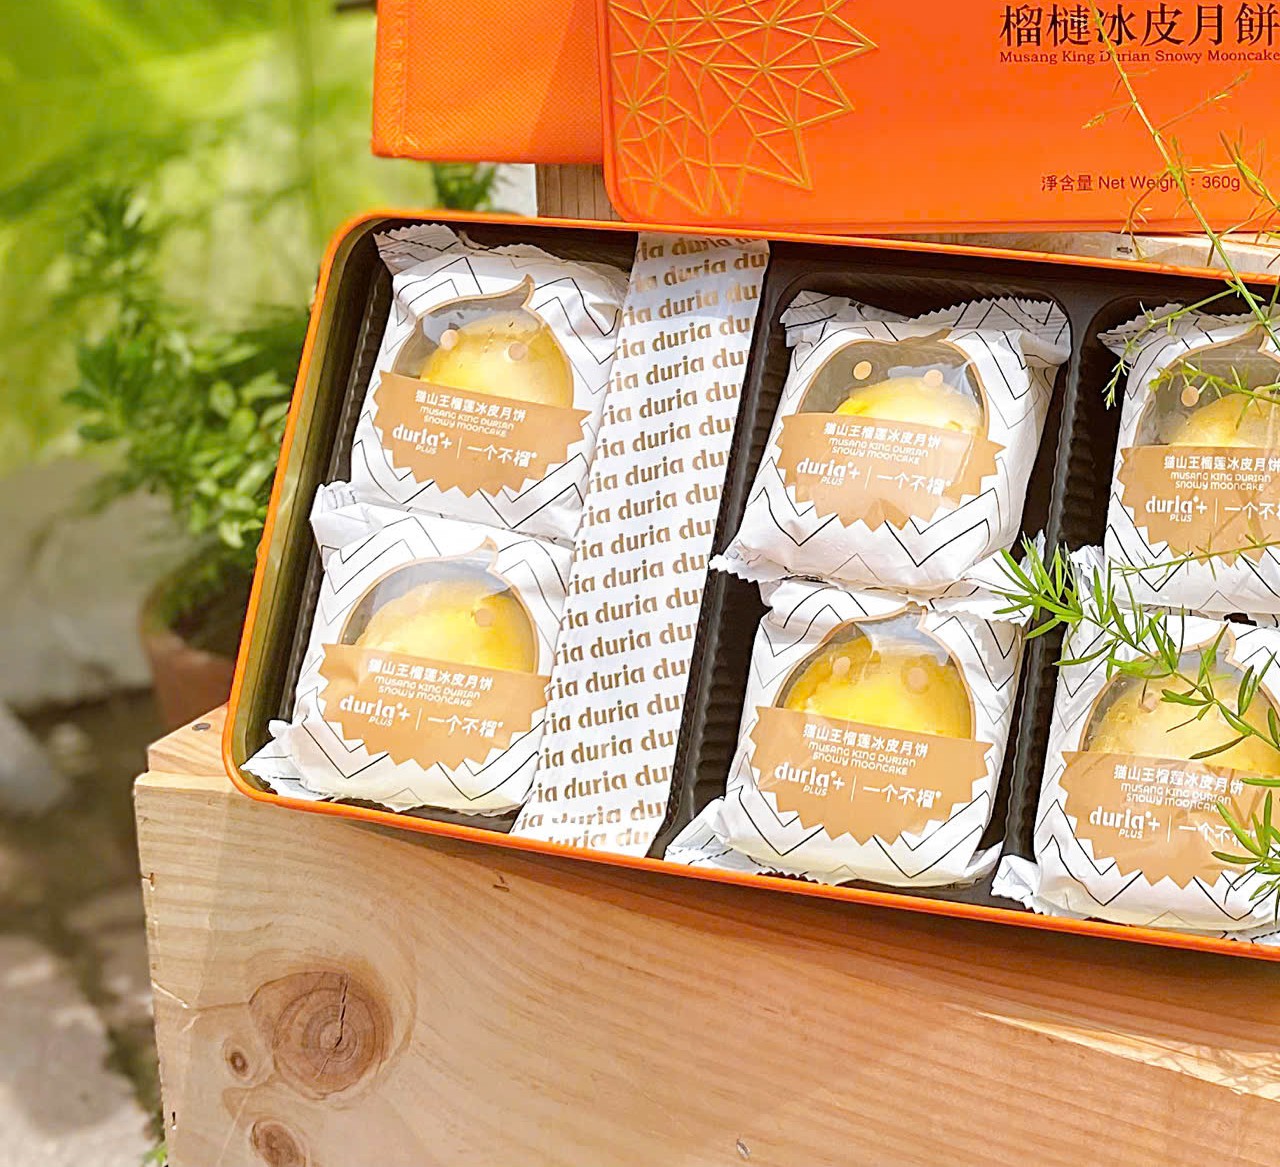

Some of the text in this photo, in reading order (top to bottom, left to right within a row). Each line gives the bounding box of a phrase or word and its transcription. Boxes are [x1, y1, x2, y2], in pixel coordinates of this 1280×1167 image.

[999, 2, 1280, 47] 榴槤冰皮月餅
[999, 50, 1058, 65] Musang
[1062, 50, 1096, 65] King
[1155, 50, 1202, 64] Snowy
[1207, 49, 1280, 62] Mooncake
[1041, 174, 1093, 192] 淨含量
[1098, 176, 1125, 190] Net
[1202, 175, 1240, 192] 360g
[658, 290, 718, 319] duria
[652, 322, 712, 351] duria
[646, 355, 704, 384] duria
[639, 388, 697, 418] duria
[415, 445, 437, 455] PLUS
[633, 422, 691, 452] duria
[625, 456, 684, 486] duria
[820, 476, 844, 485] PLUS
[618, 490, 677, 520] duria
[1170, 514, 1192, 522] PLUS
[610, 525, 671, 555] duria
[603, 559, 664, 588] duria
[595, 594, 657, 623] duria
[590, 629, 651, 658] duria
[585, 664, 645, 692] duria
[369, 717, 393, 727] PLUS
[578, 700, 639, 728] duria
[571, 735, 632, 764] duria
[564, 770, 627, 799] duria
[803, 785, 827, 797] PLUS
[1118, 828, 1143, 839] PLUS
